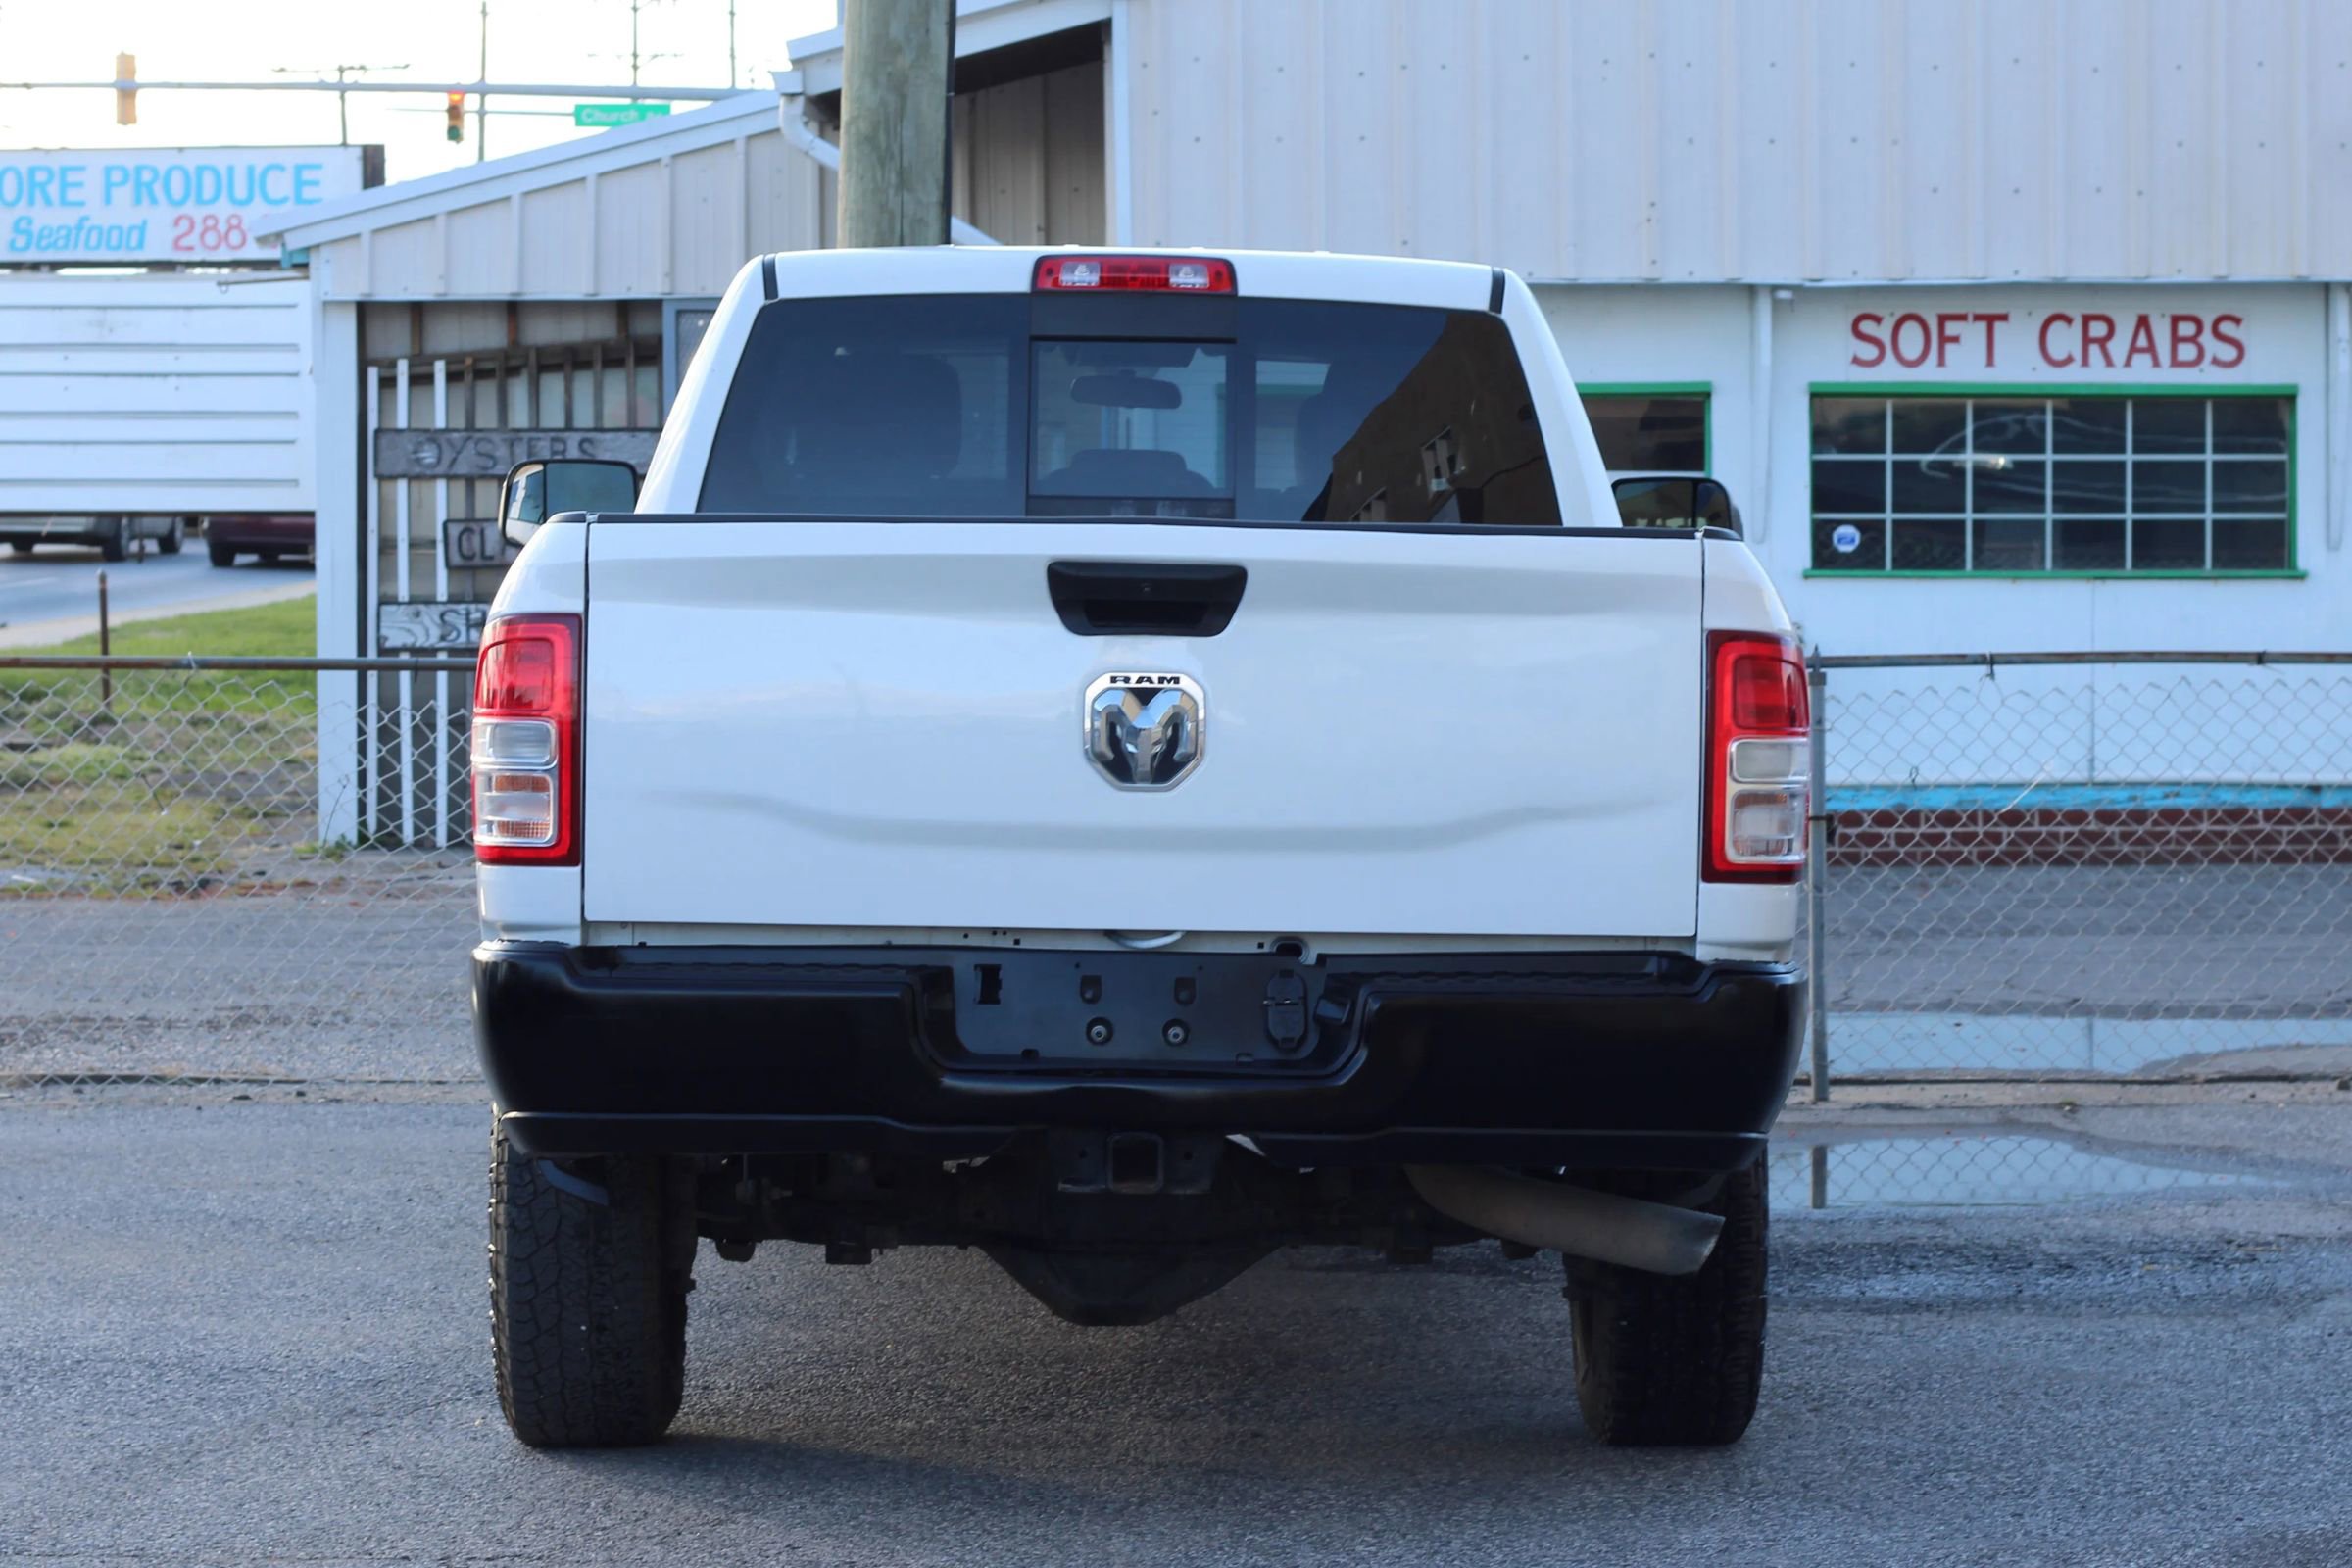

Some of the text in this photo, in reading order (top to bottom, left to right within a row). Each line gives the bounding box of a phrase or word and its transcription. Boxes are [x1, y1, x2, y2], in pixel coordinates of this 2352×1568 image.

[0, 163, 324, 208] ORE PRODUCE
[8, 214, 148, 252] Seafood
[1849, 312, 2246, 369] SOFT CRABS
[1109, 675, 1181, 685] RAM
